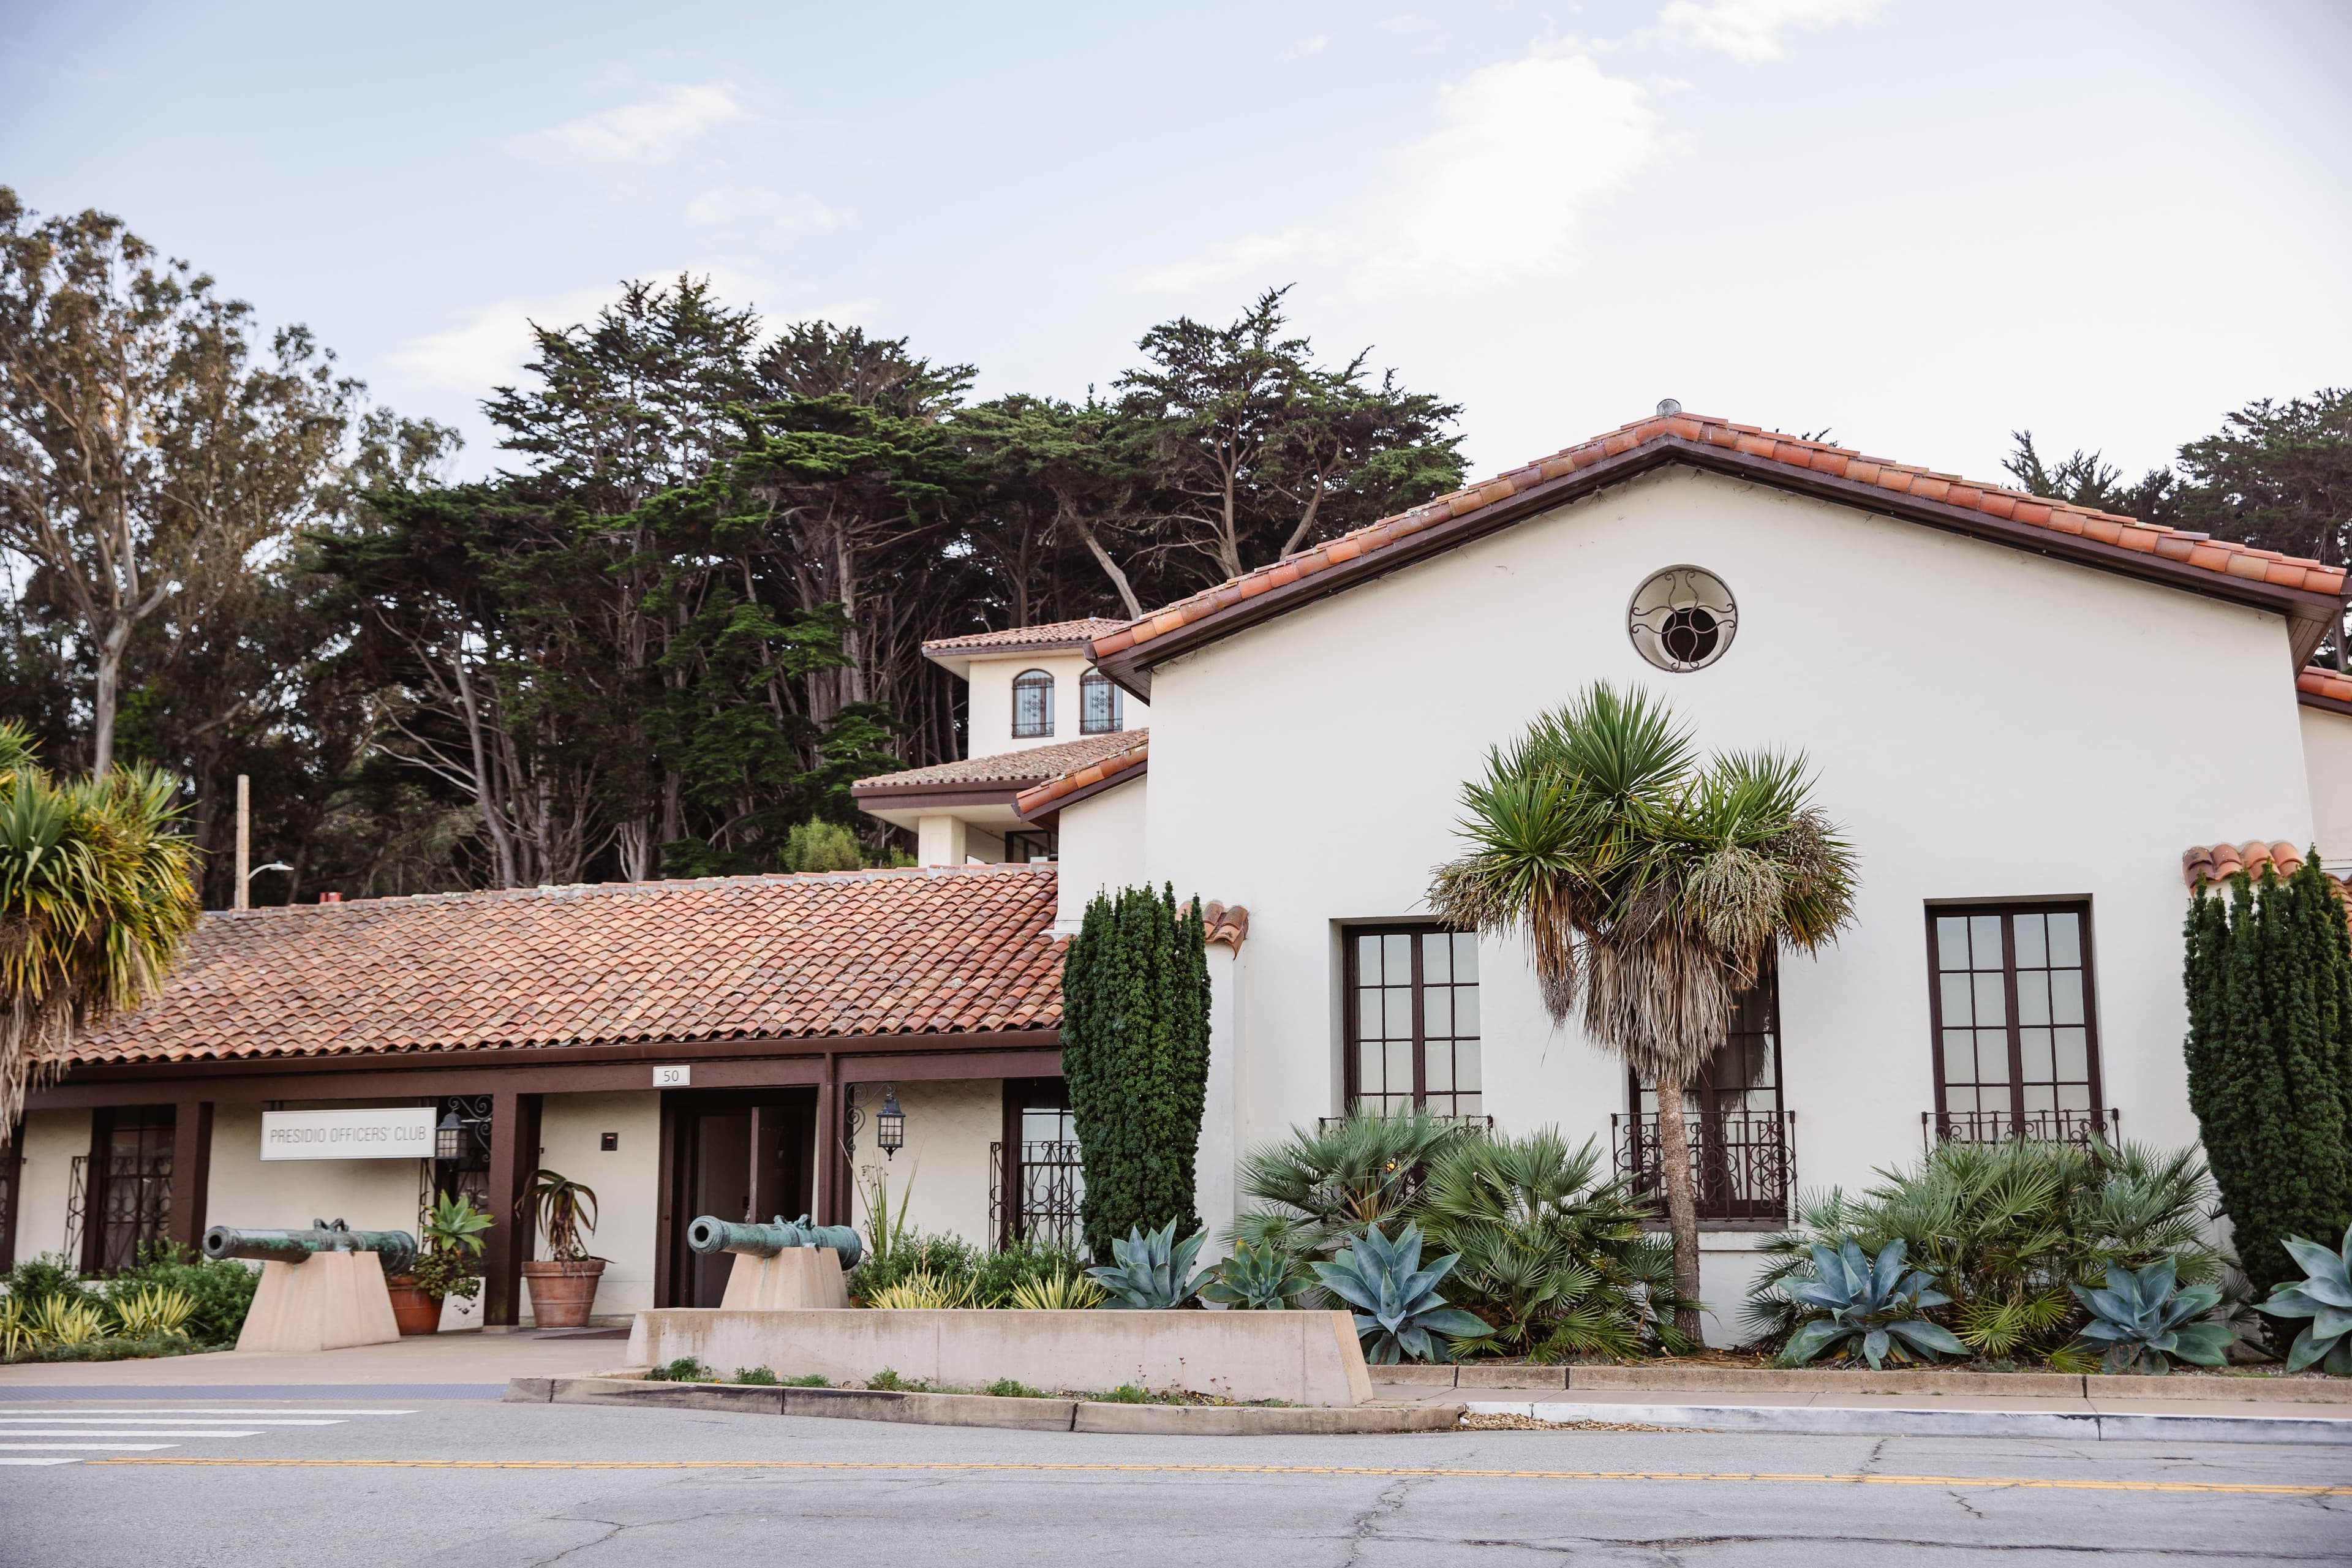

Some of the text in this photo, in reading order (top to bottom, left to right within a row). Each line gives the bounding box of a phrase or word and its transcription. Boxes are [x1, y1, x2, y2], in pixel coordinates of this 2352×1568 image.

[663, 1070, 679, 1082] 50
[270, 1128, 325, 1144] PRESIDIO
[394, 1126, 427, 1141] CLUB
